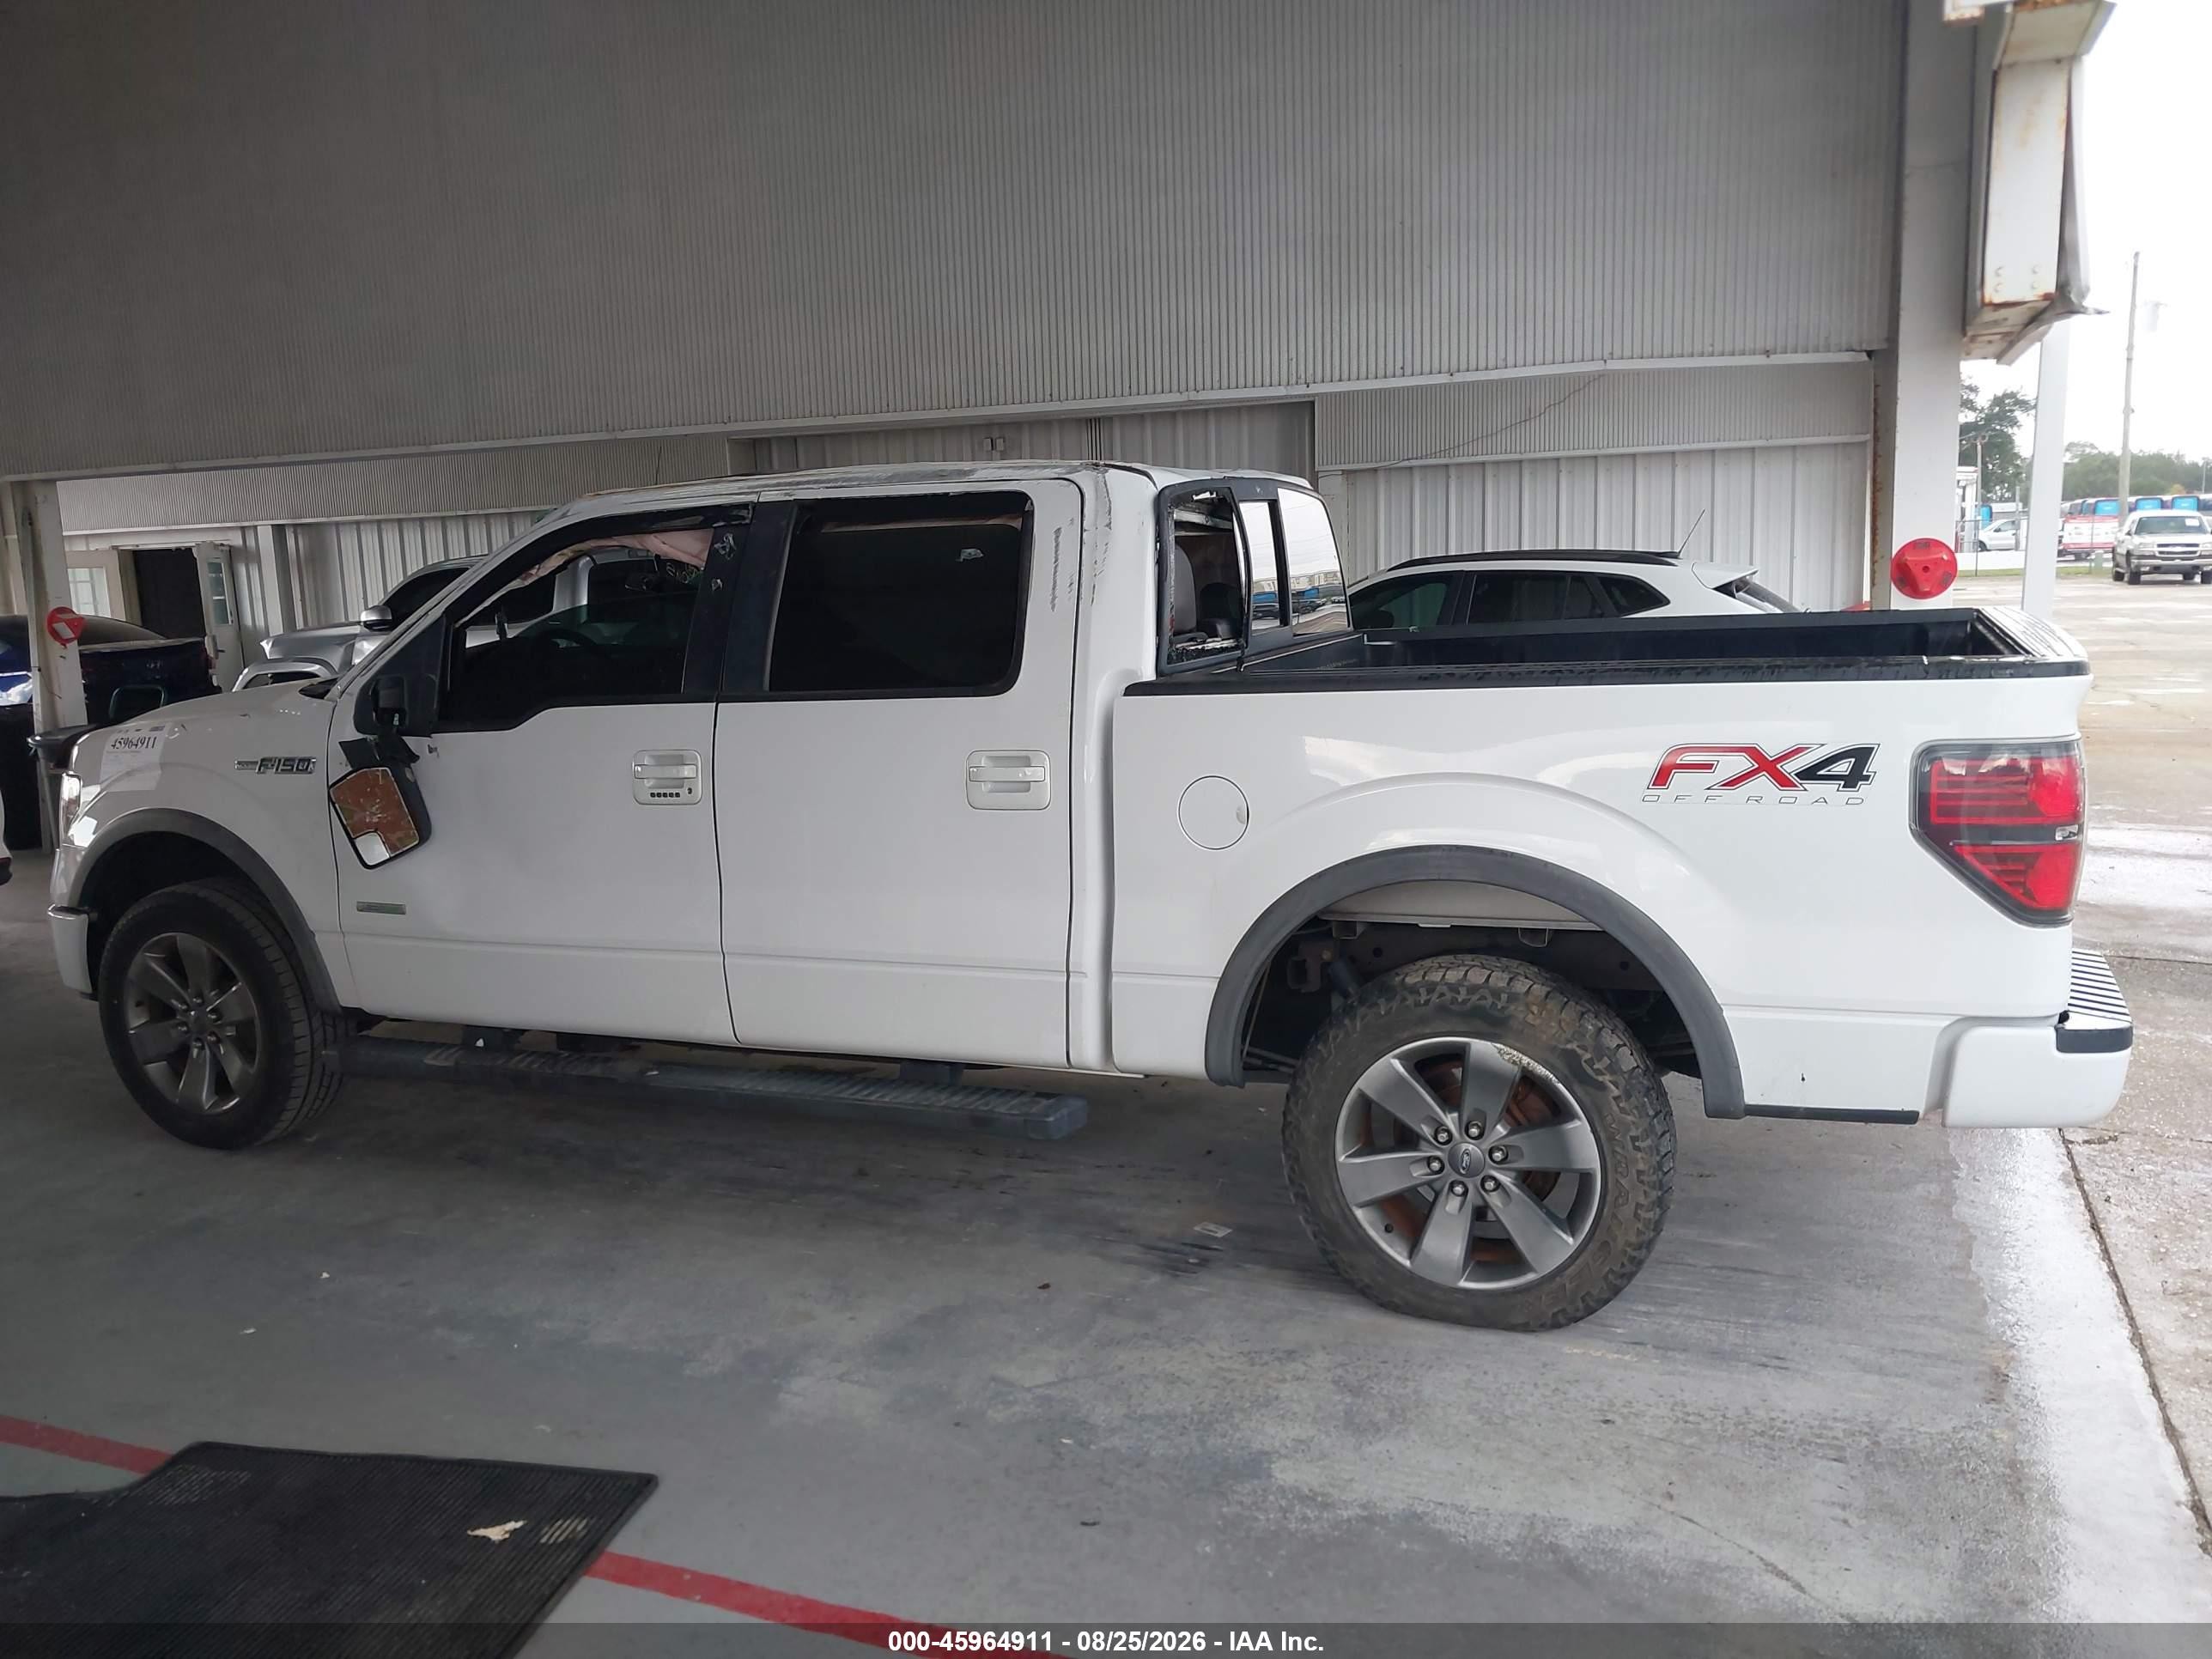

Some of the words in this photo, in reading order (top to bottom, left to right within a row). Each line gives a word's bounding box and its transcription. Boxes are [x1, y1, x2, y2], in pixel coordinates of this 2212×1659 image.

[111, 737, 156, 749] 45964911
[1647, 743, 1881, 792] FX4
[1642, 794, 1723, 803] OFF
[1746, 795, 1865, 805] ROAD
